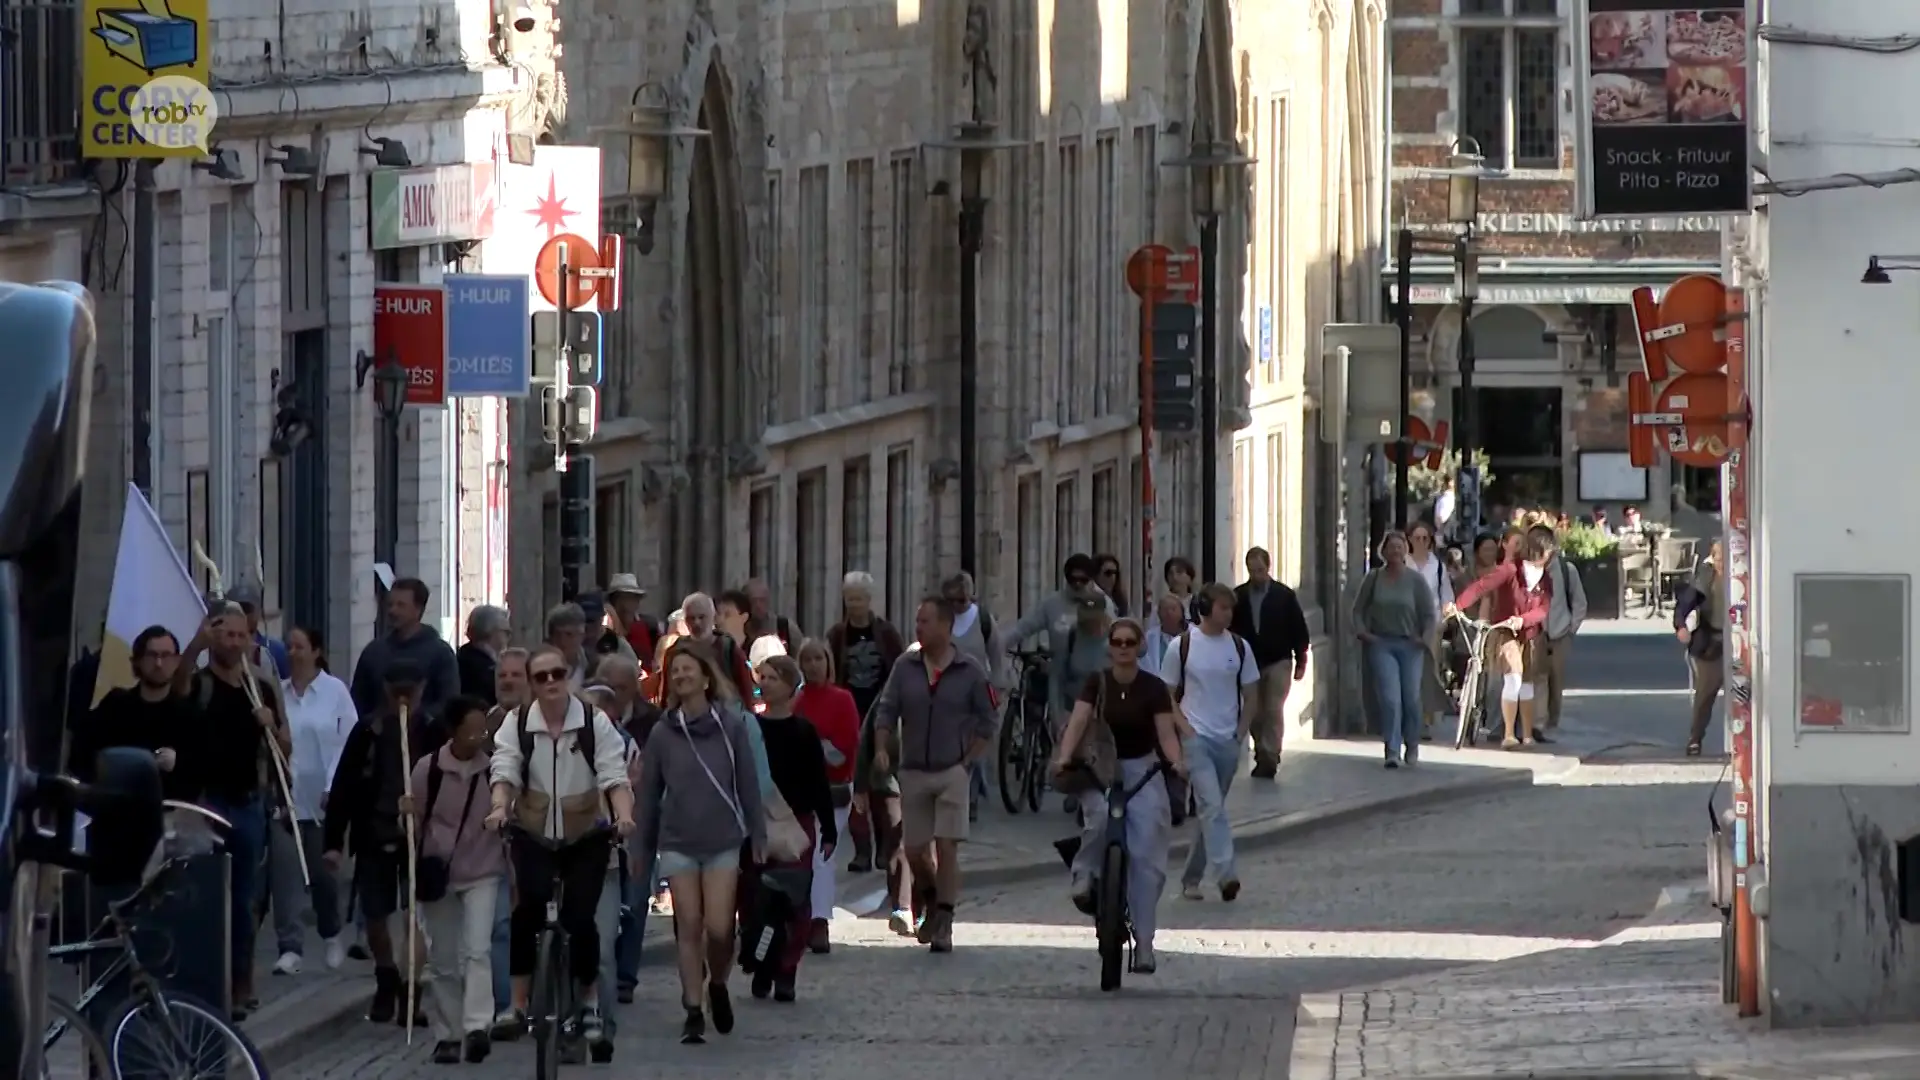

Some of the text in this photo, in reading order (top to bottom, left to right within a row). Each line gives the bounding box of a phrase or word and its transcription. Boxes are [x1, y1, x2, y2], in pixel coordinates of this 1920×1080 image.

[92, 84, 200, 116] COPY
[92, 122, 198, 145] CENTER
[1606, 148, 1662, 165] Snack
[1677, 147, 1732, 164] Frituur
[1620, 171, 1660, 188] Pitta
[1676, 171, 1720, 188] Pizza
[459, 286, 512, 305] HUUR
[386, 297, 432, 315] HUUR
